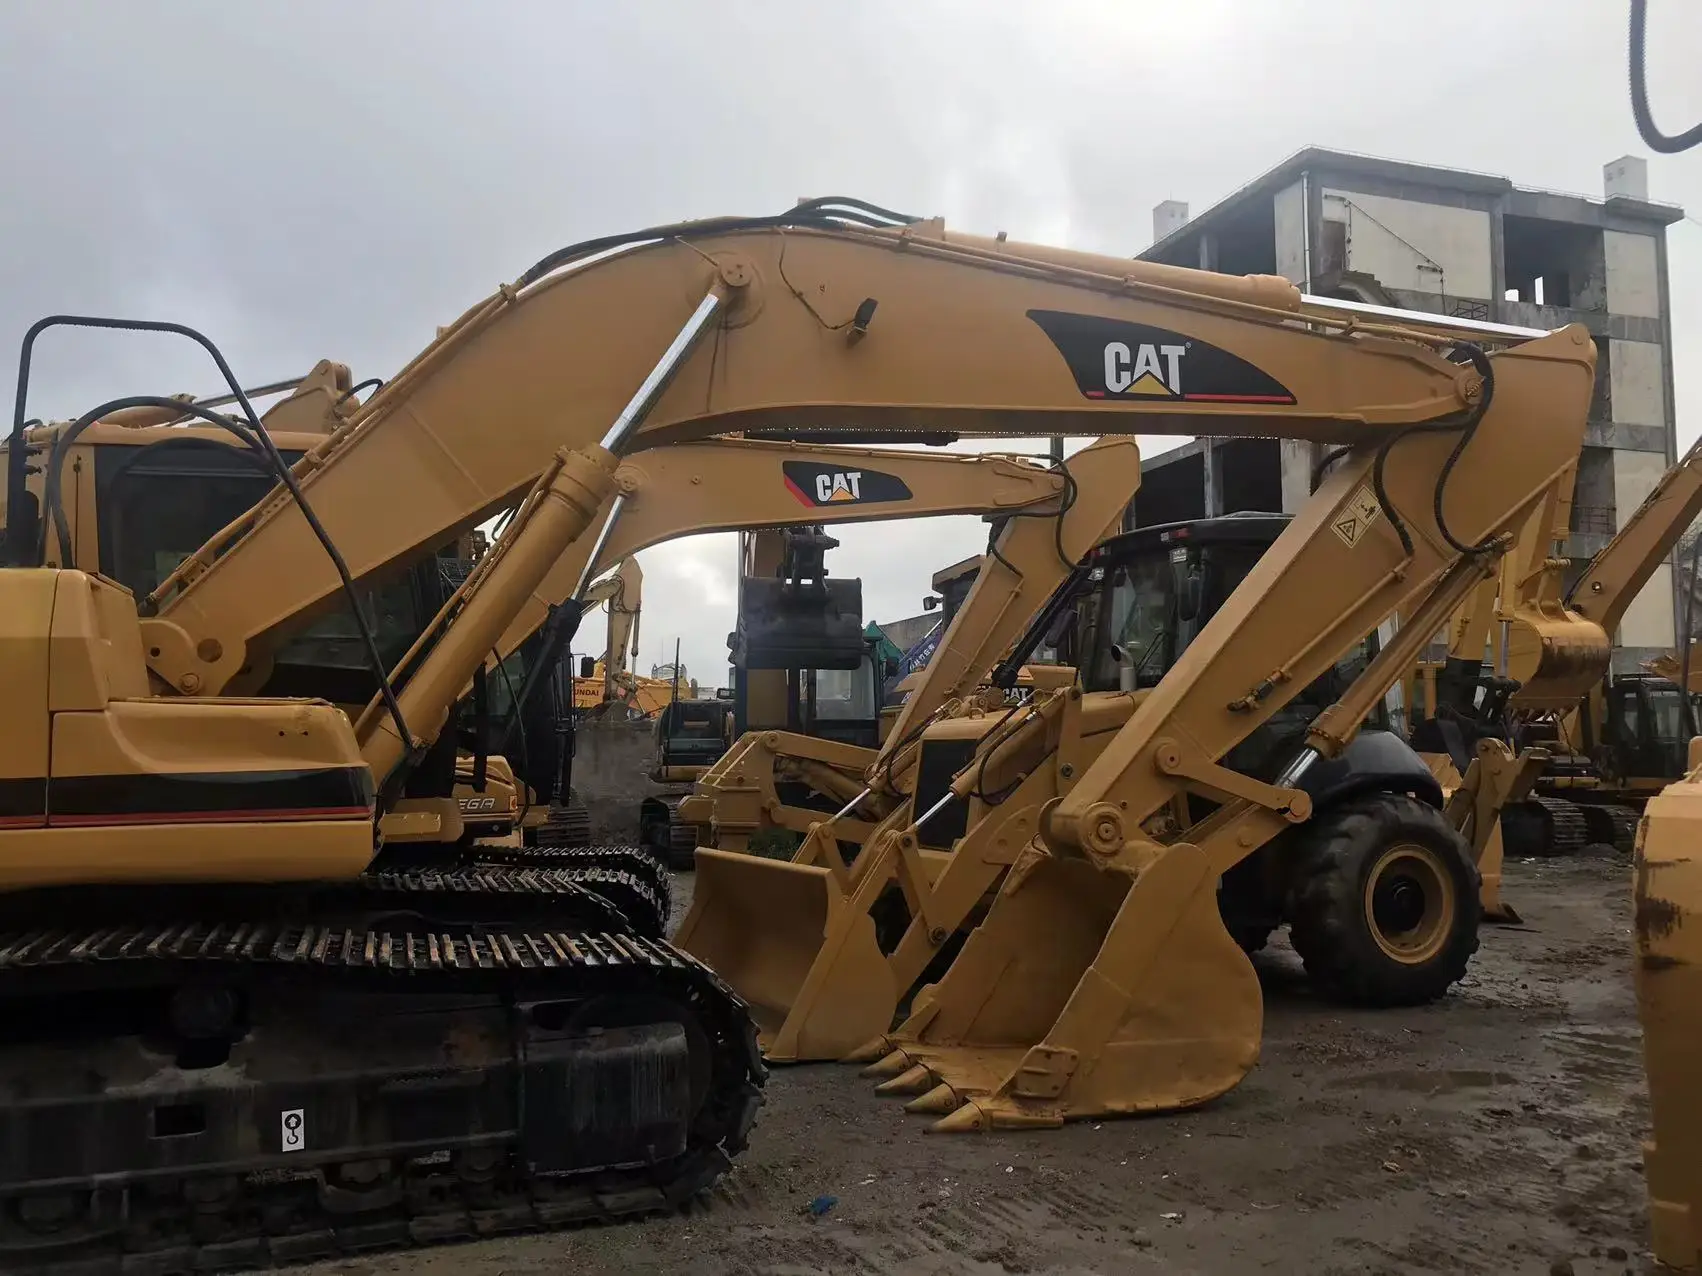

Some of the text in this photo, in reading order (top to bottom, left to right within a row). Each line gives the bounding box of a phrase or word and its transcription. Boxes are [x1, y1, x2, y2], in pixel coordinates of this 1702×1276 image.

[1104, 342, 1186, 395] CAT
[816, 472, 861, 501] CAT
[1003, 687, 1028, 703] CAT
